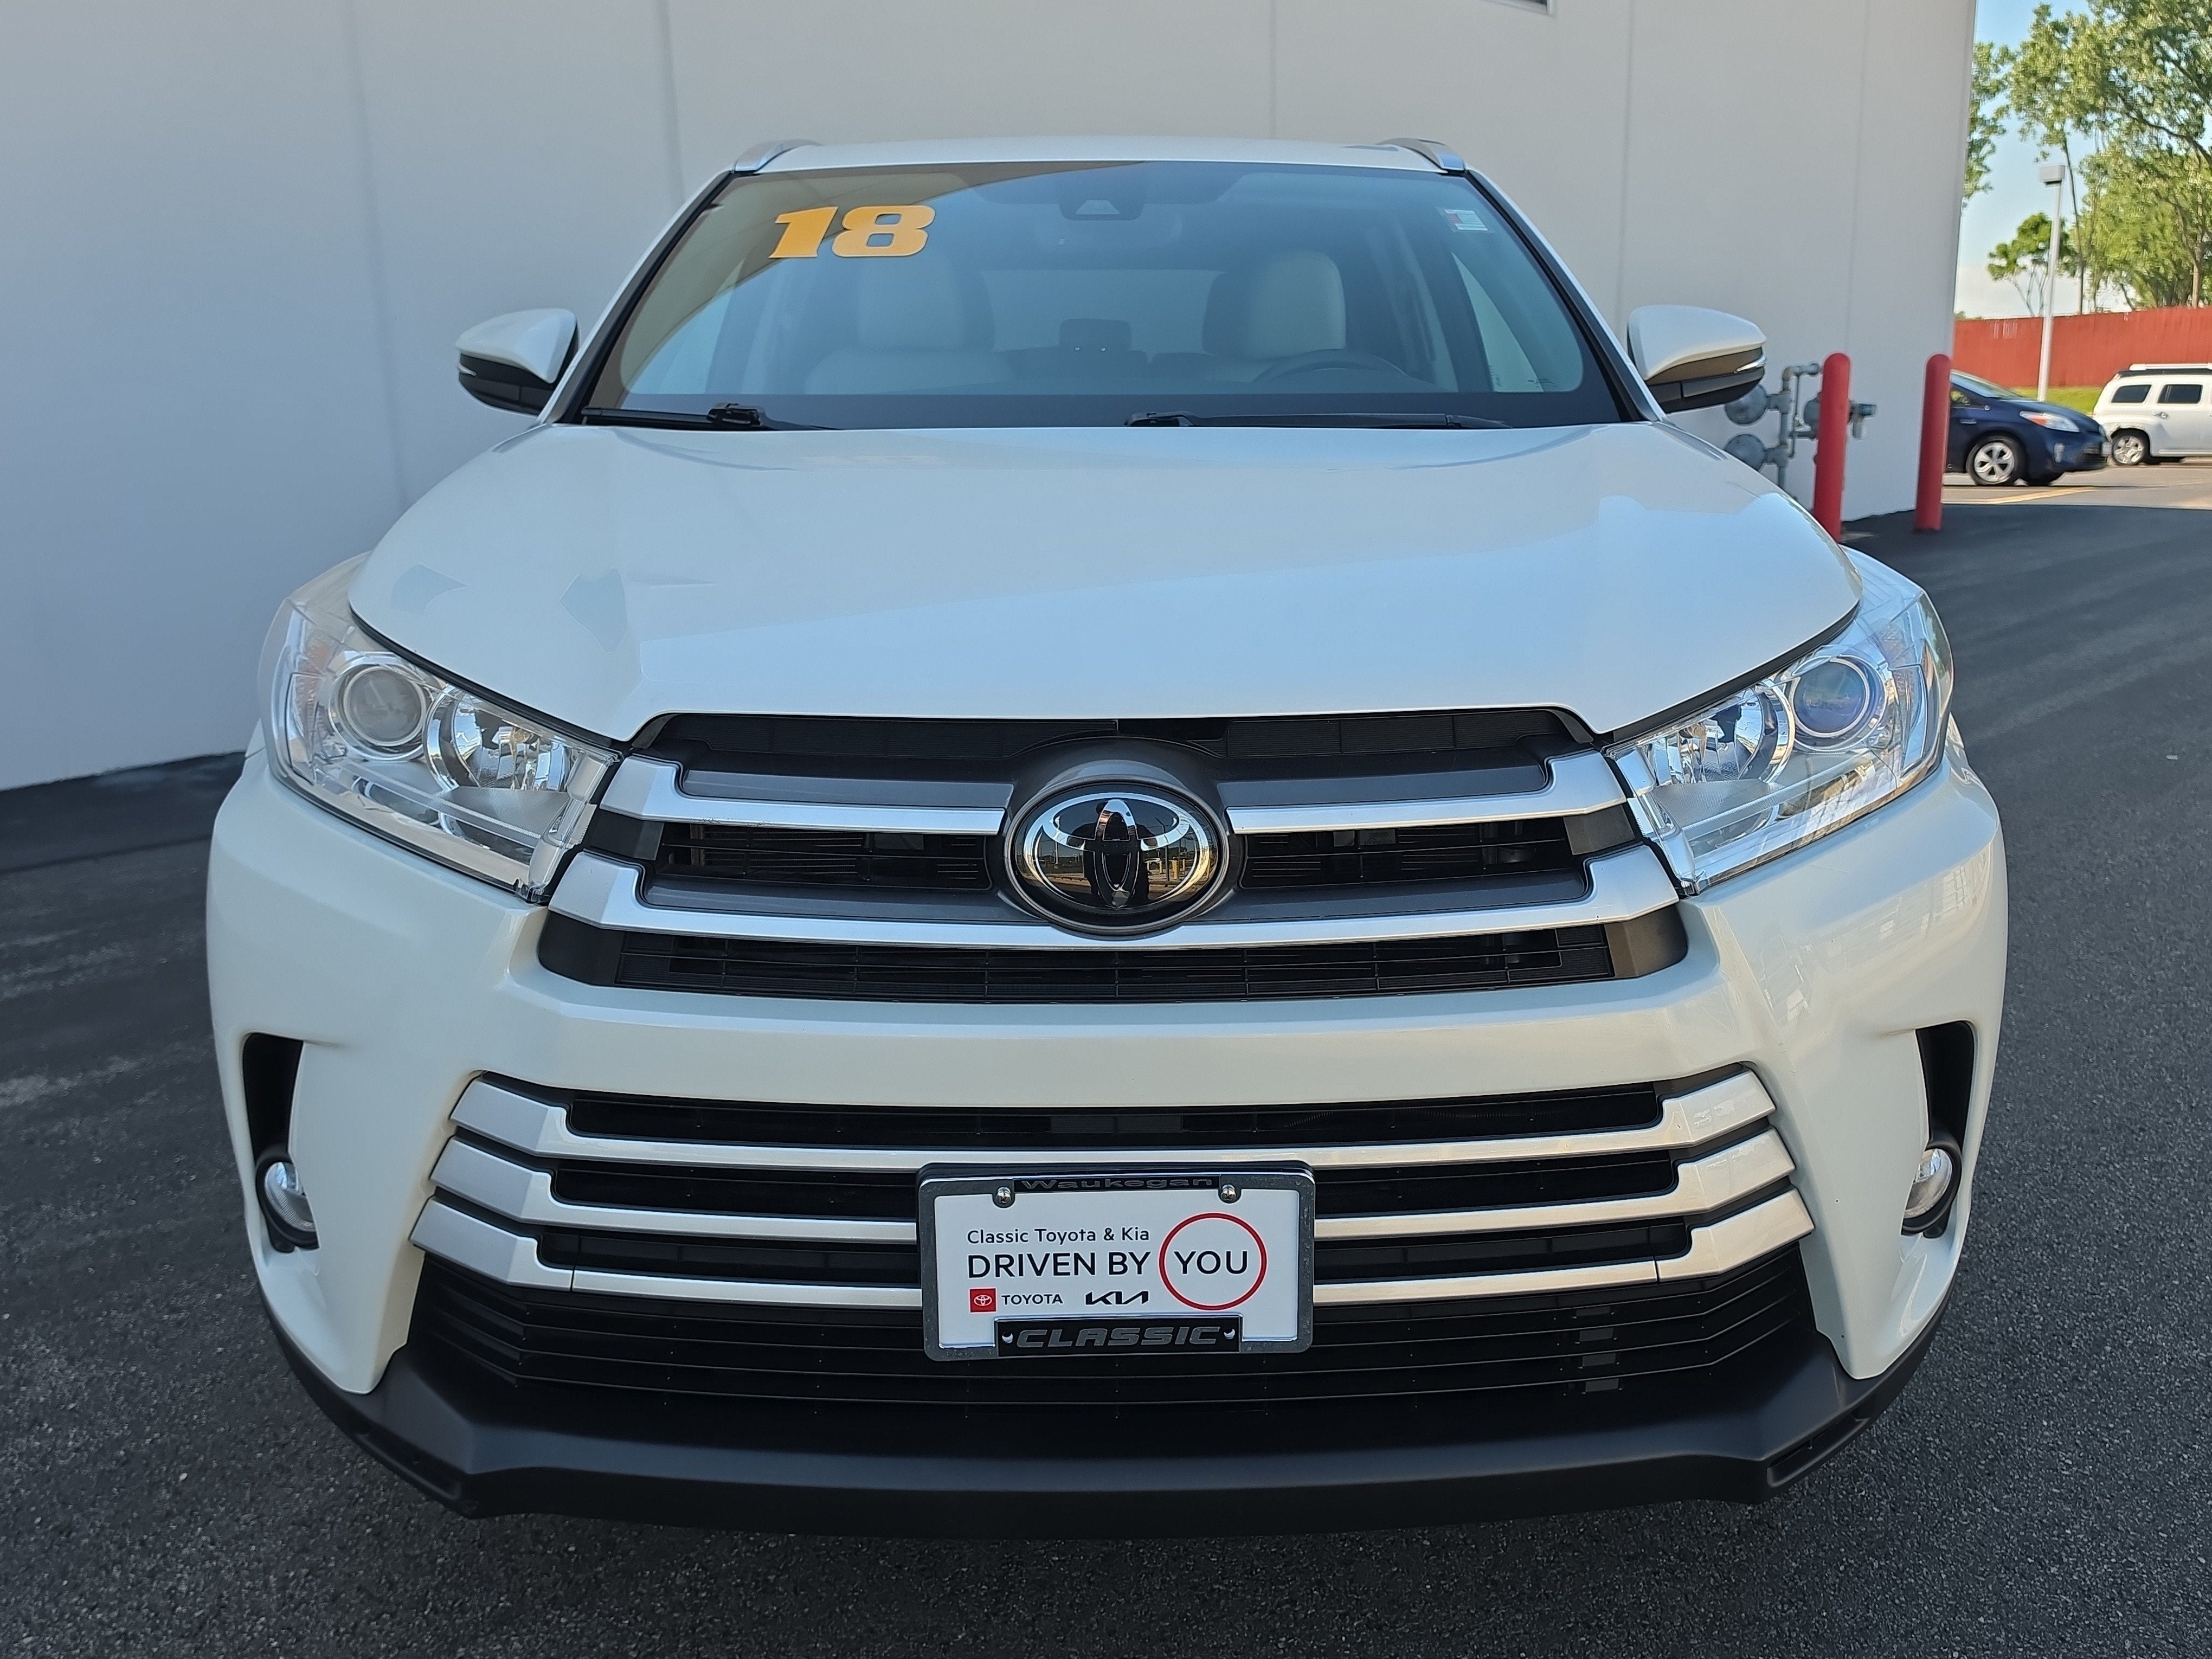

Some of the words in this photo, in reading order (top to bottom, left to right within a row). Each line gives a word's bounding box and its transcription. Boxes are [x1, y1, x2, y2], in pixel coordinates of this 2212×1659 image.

[768, 204, 936, 259] 18
[1021, 1176, 1212, 1189] Waukegan
[967, 1229, 1028, 1244] Classic
[1034, 1227, 1096, 1246] Toyota
[1104, 1229, 1115, 1242] &
[1122, 1227, 1149, 1241] Kia
[968, 1252, 1096, 1278] DRIVEN
[1108, 1251, 1152, 1275] BY
[1173, 1250, 1248, 1275] YOU
[1001, 1294, 1063, 1306] TOYOTA
[1017, 1326, 1220, 1348] CLASSIC
